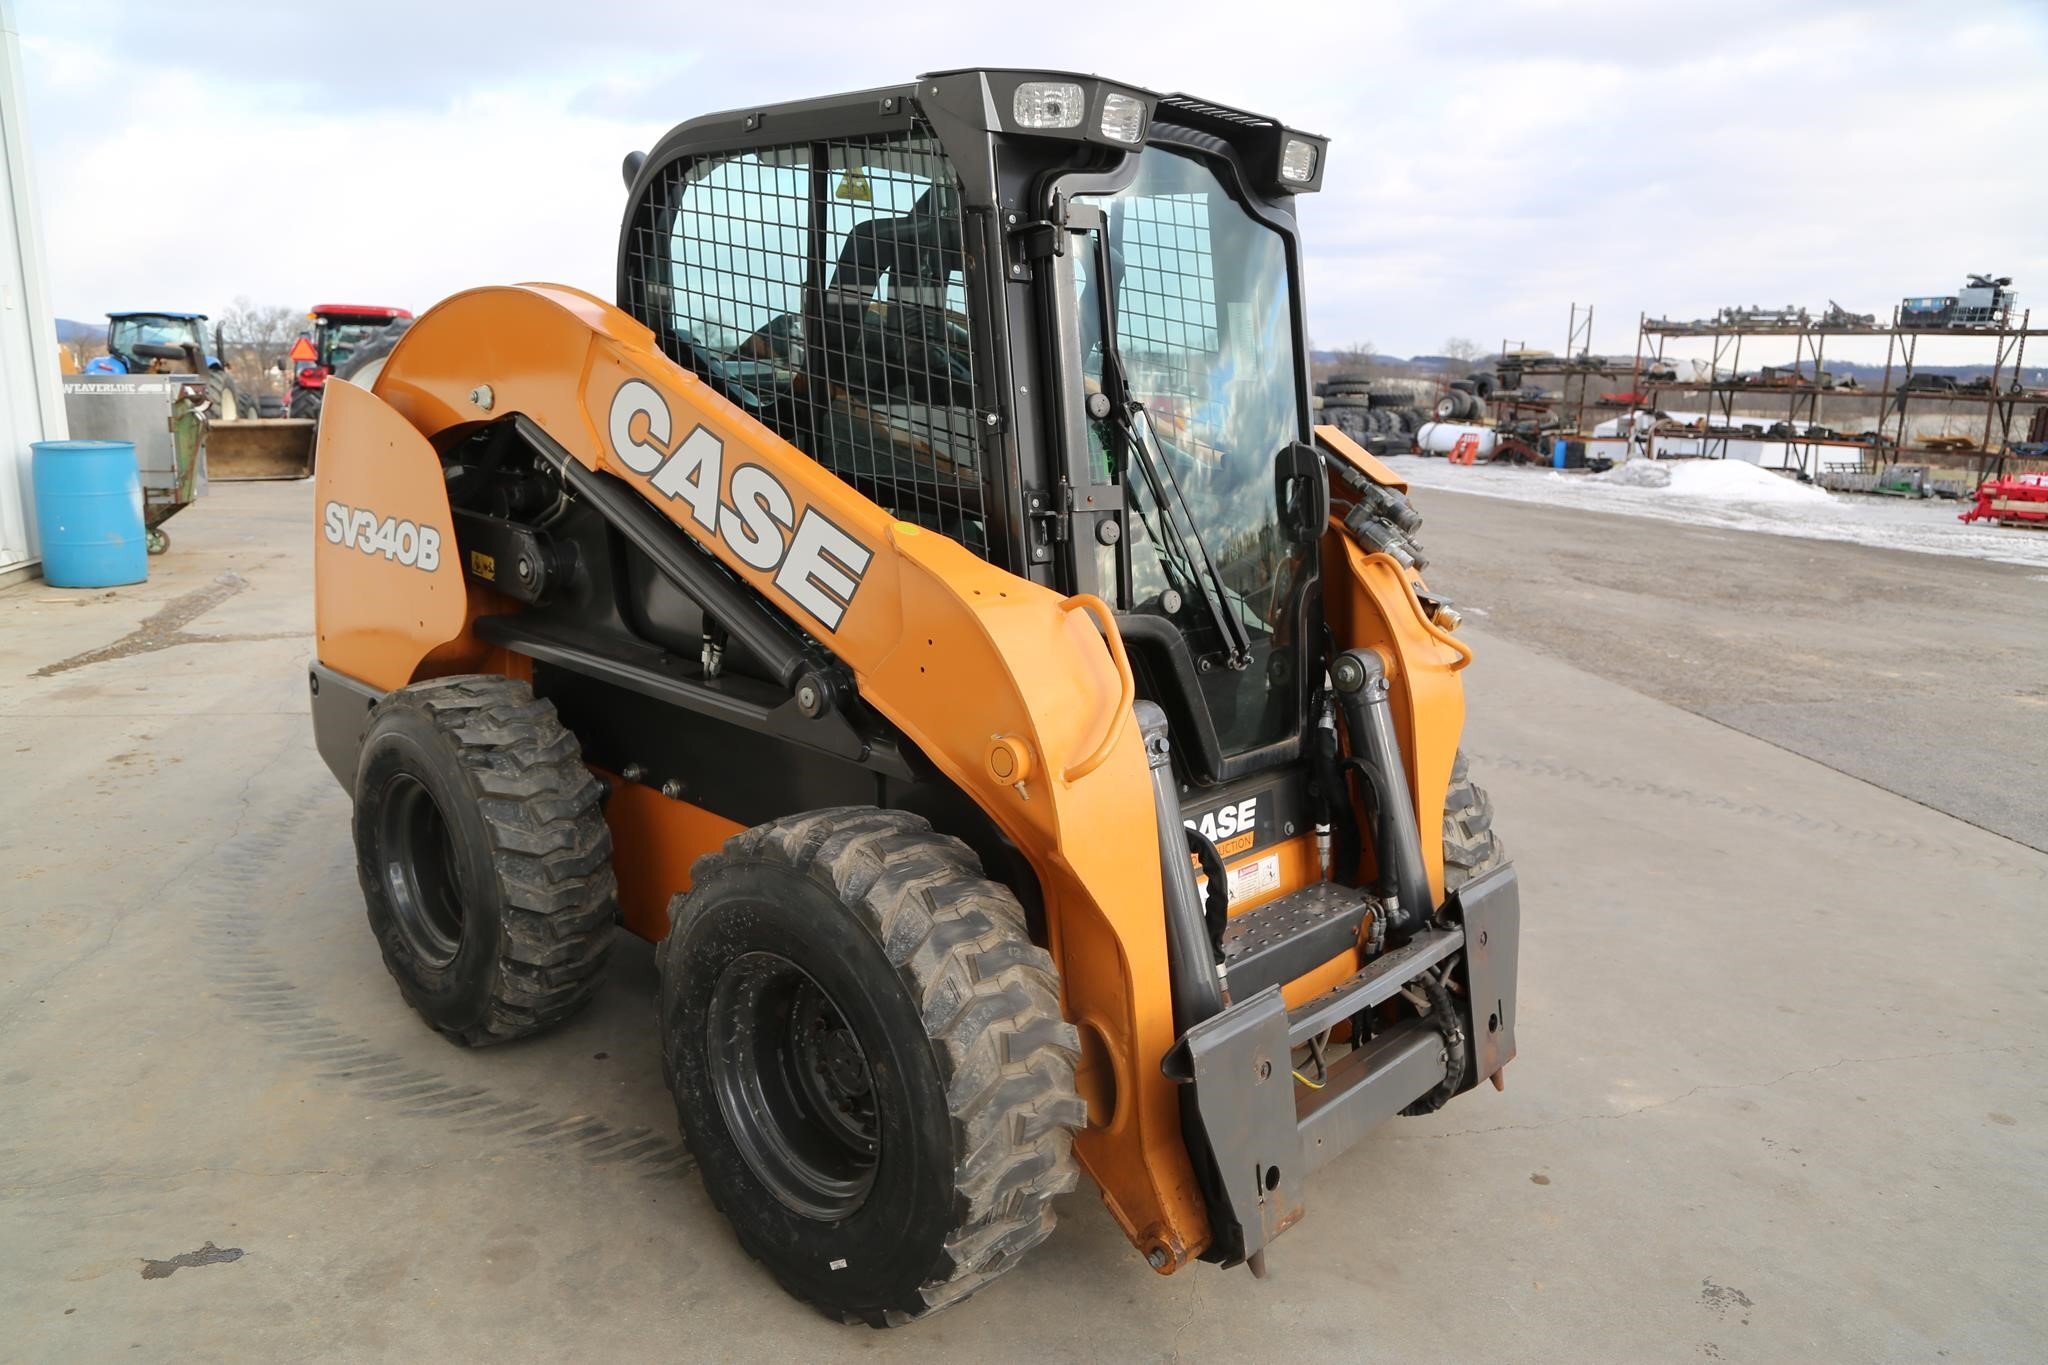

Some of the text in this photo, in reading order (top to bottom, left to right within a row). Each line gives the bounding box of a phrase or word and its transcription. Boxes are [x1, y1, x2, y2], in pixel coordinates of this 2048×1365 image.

[63, 383, 136, 394] WEAVERLINE
[324, 500, 440, 572] SV340B
[608, 377, 875, 635] CASE
